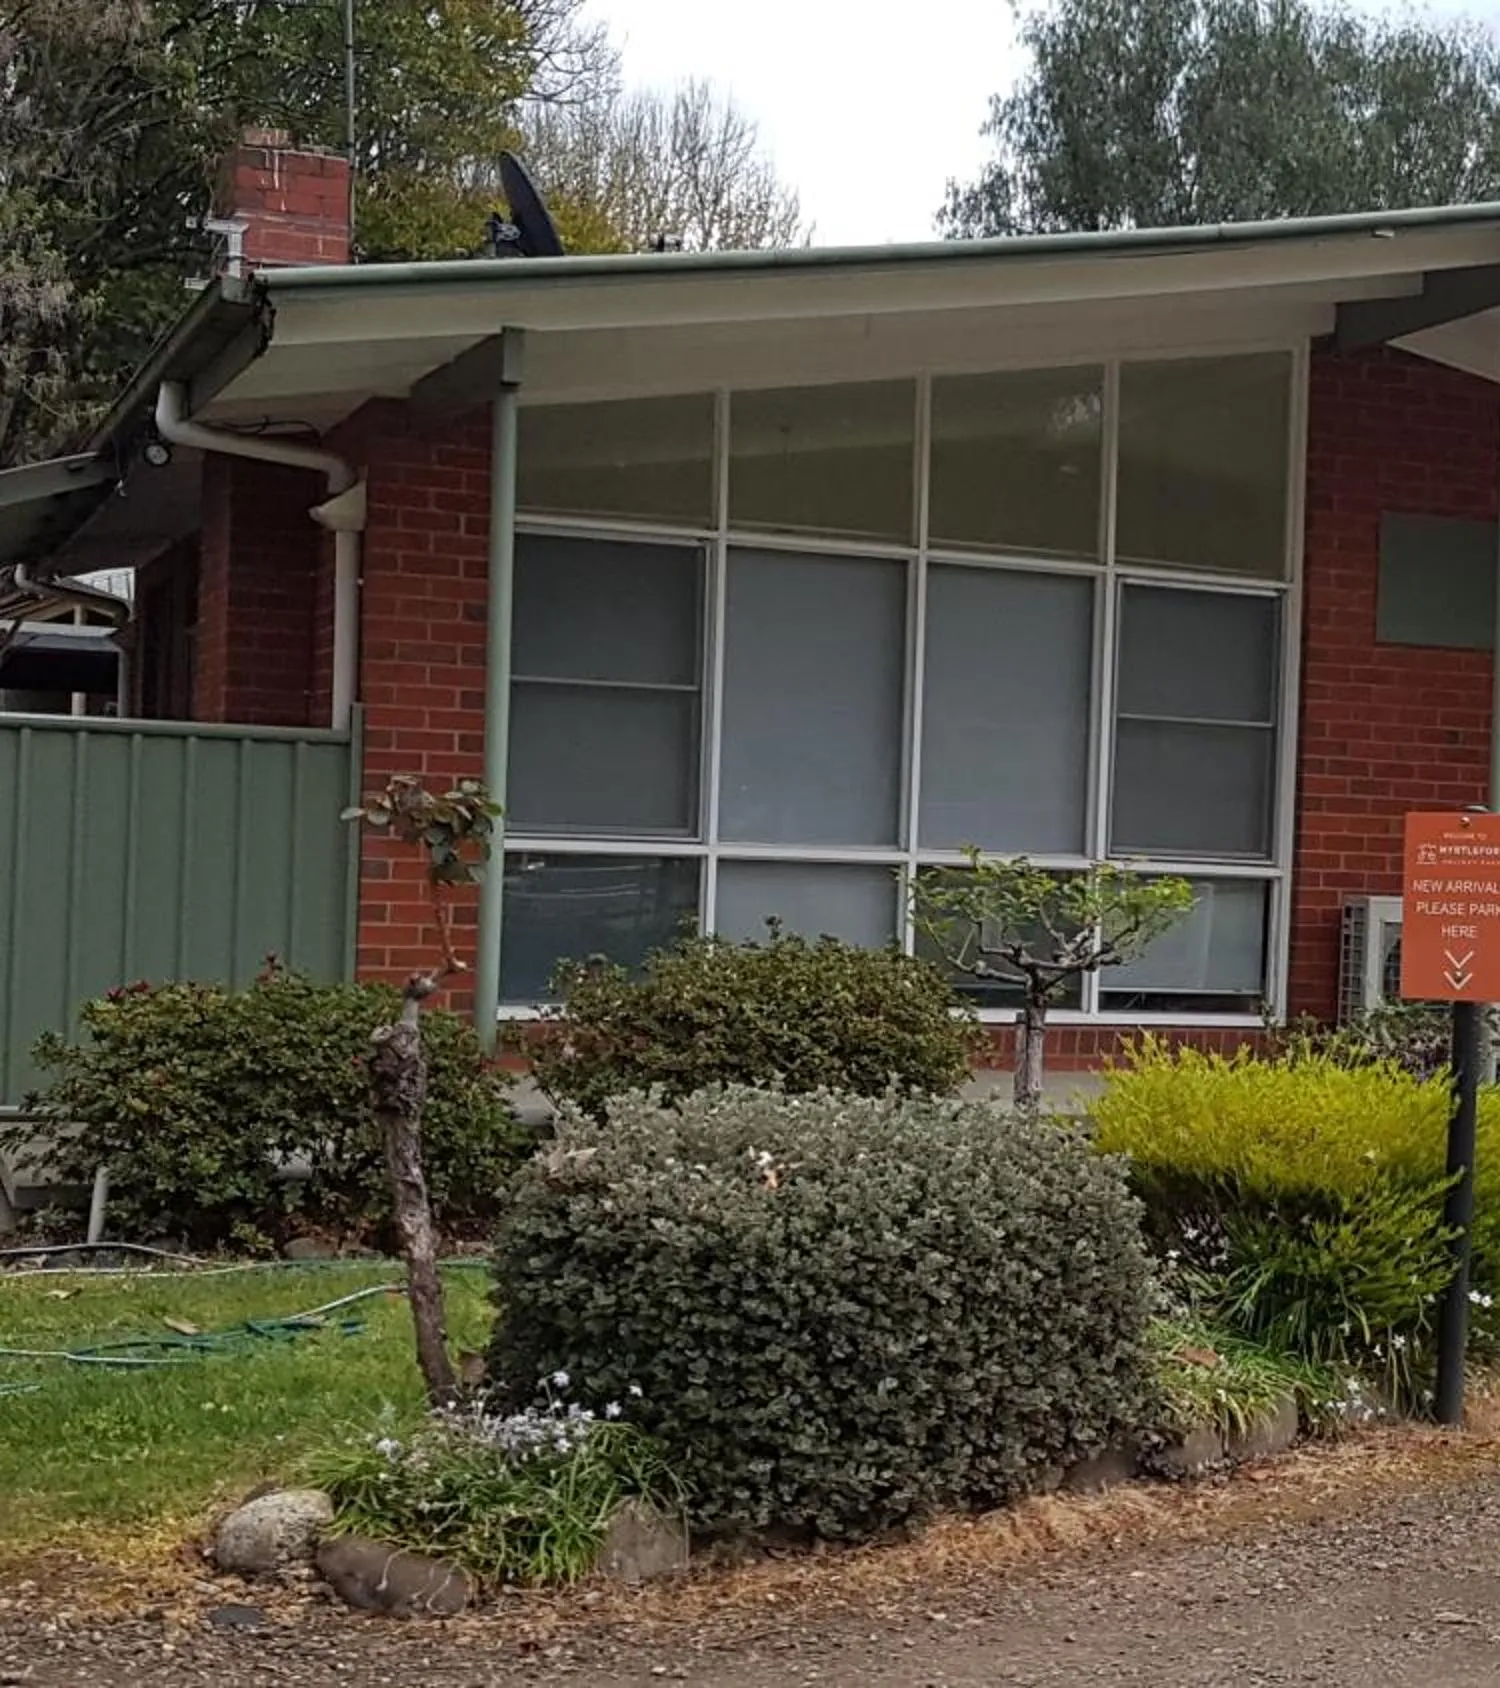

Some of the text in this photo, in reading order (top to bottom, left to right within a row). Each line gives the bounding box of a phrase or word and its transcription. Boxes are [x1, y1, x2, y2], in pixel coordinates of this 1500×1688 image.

[1412, 879, 1443, 894] NEW
[1415, 901, 1466, 916] PLEASE
[1440, 925, 1479, 938] HERE
